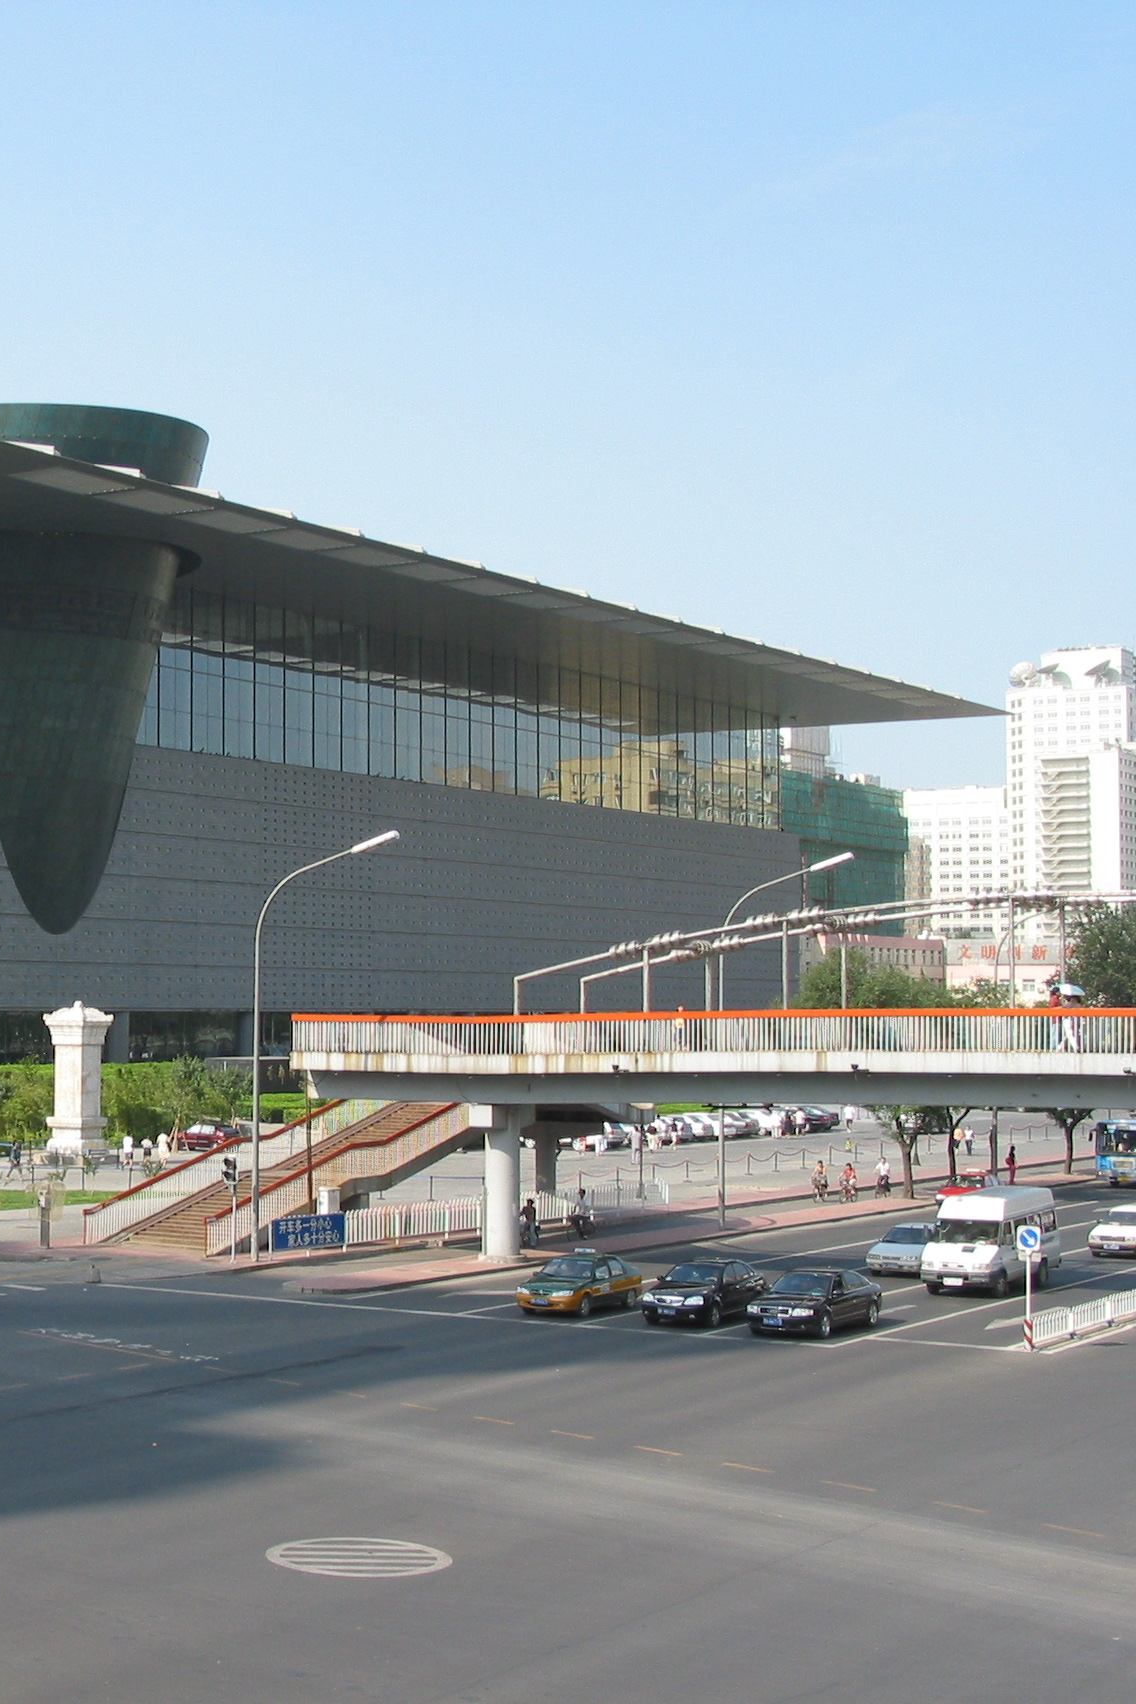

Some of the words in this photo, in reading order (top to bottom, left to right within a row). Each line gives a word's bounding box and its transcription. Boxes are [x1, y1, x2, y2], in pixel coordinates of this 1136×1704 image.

[279, 1217, 332, 1234] 开车多一分小心
